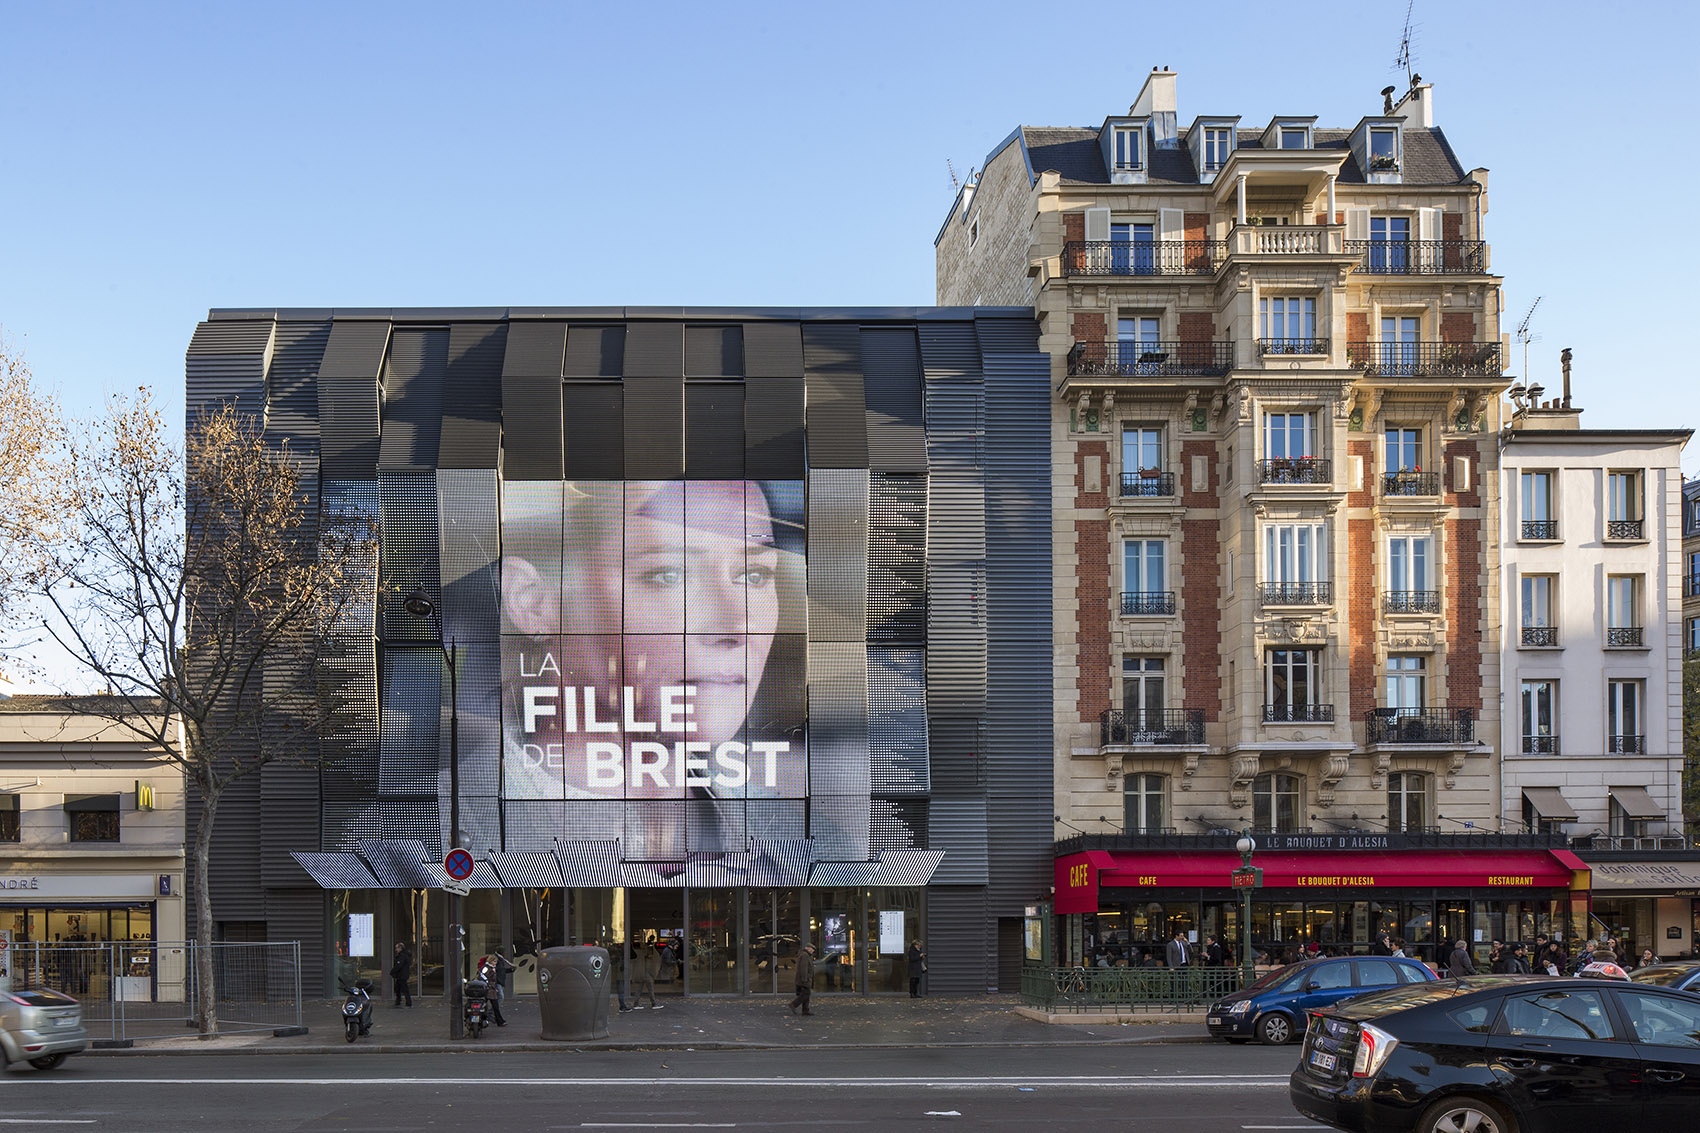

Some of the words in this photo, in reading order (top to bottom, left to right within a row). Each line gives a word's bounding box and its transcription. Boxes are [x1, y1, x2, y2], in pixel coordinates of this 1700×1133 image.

[519, 652, 561, 677] LA
[523, 686, 698, 733] FILLE
[522, 743, 565, 768] DE
[586, 741, 790, 788] BREST
[1267, 836, 1280, 848] LE
[1599, 863, 1680, 875] dominique
[1070, 864, 1088, 888] CAFE
[1138, 876, 1157, 886] CAFE
[1297, 876, 1307, 886] LE
[1308, 876, 1341, 886] BOUQUET
[1342, 876, 1375, 886] D'ALESIA
[1488, 876, 1534, 886] RESTAURANT
